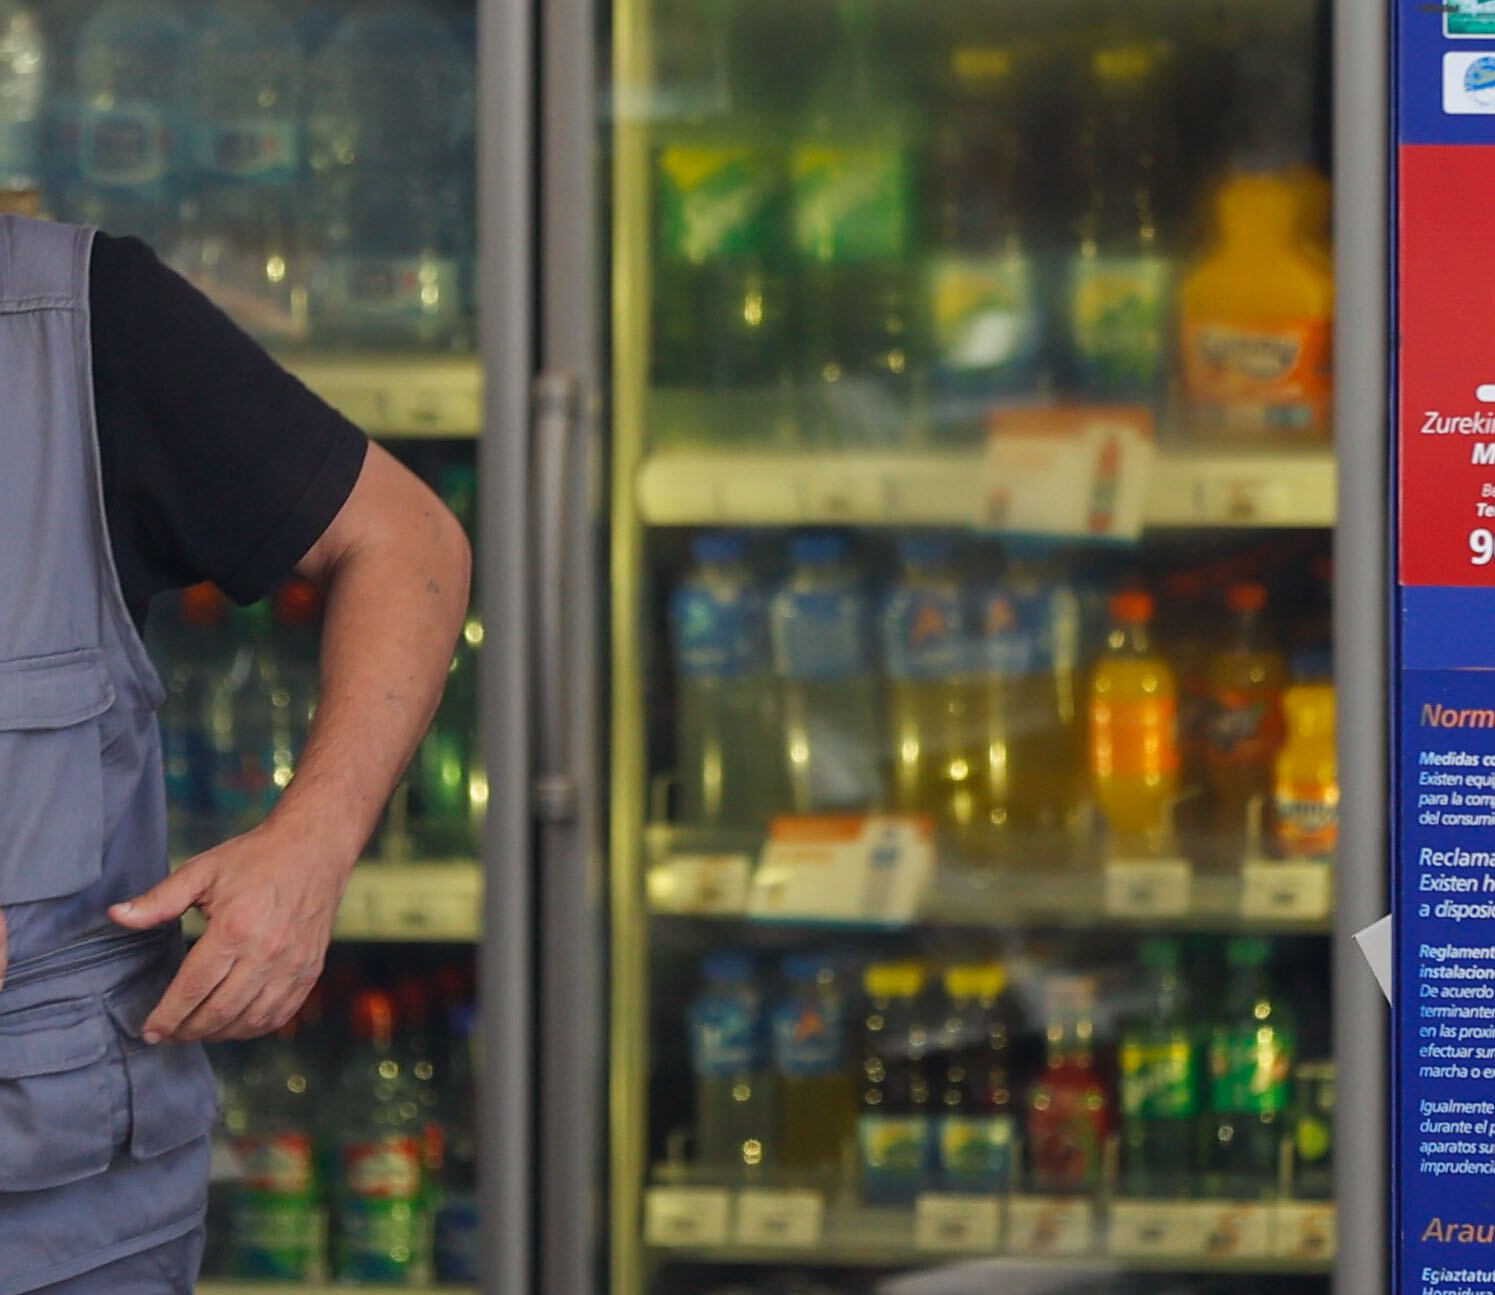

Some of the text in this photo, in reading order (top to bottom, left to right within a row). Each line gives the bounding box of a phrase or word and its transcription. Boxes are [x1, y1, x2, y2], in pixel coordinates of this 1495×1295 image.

[1418, 751, 1479, 766] Medidas
[1418, 873, 1478, 892] Existen
[1419, 983, 1439, 997] De
[1439, 983, 1494, 998] acuerdo
[1419, 1026, 1437, 1037] en
[1438, 1024, 1457, 1038] las
[1418, 1044, 1474, 1058] efectuar
[1419, 1064, 1468, 1078] marcha
[1421, 1217, 1495, 1243] Arau
